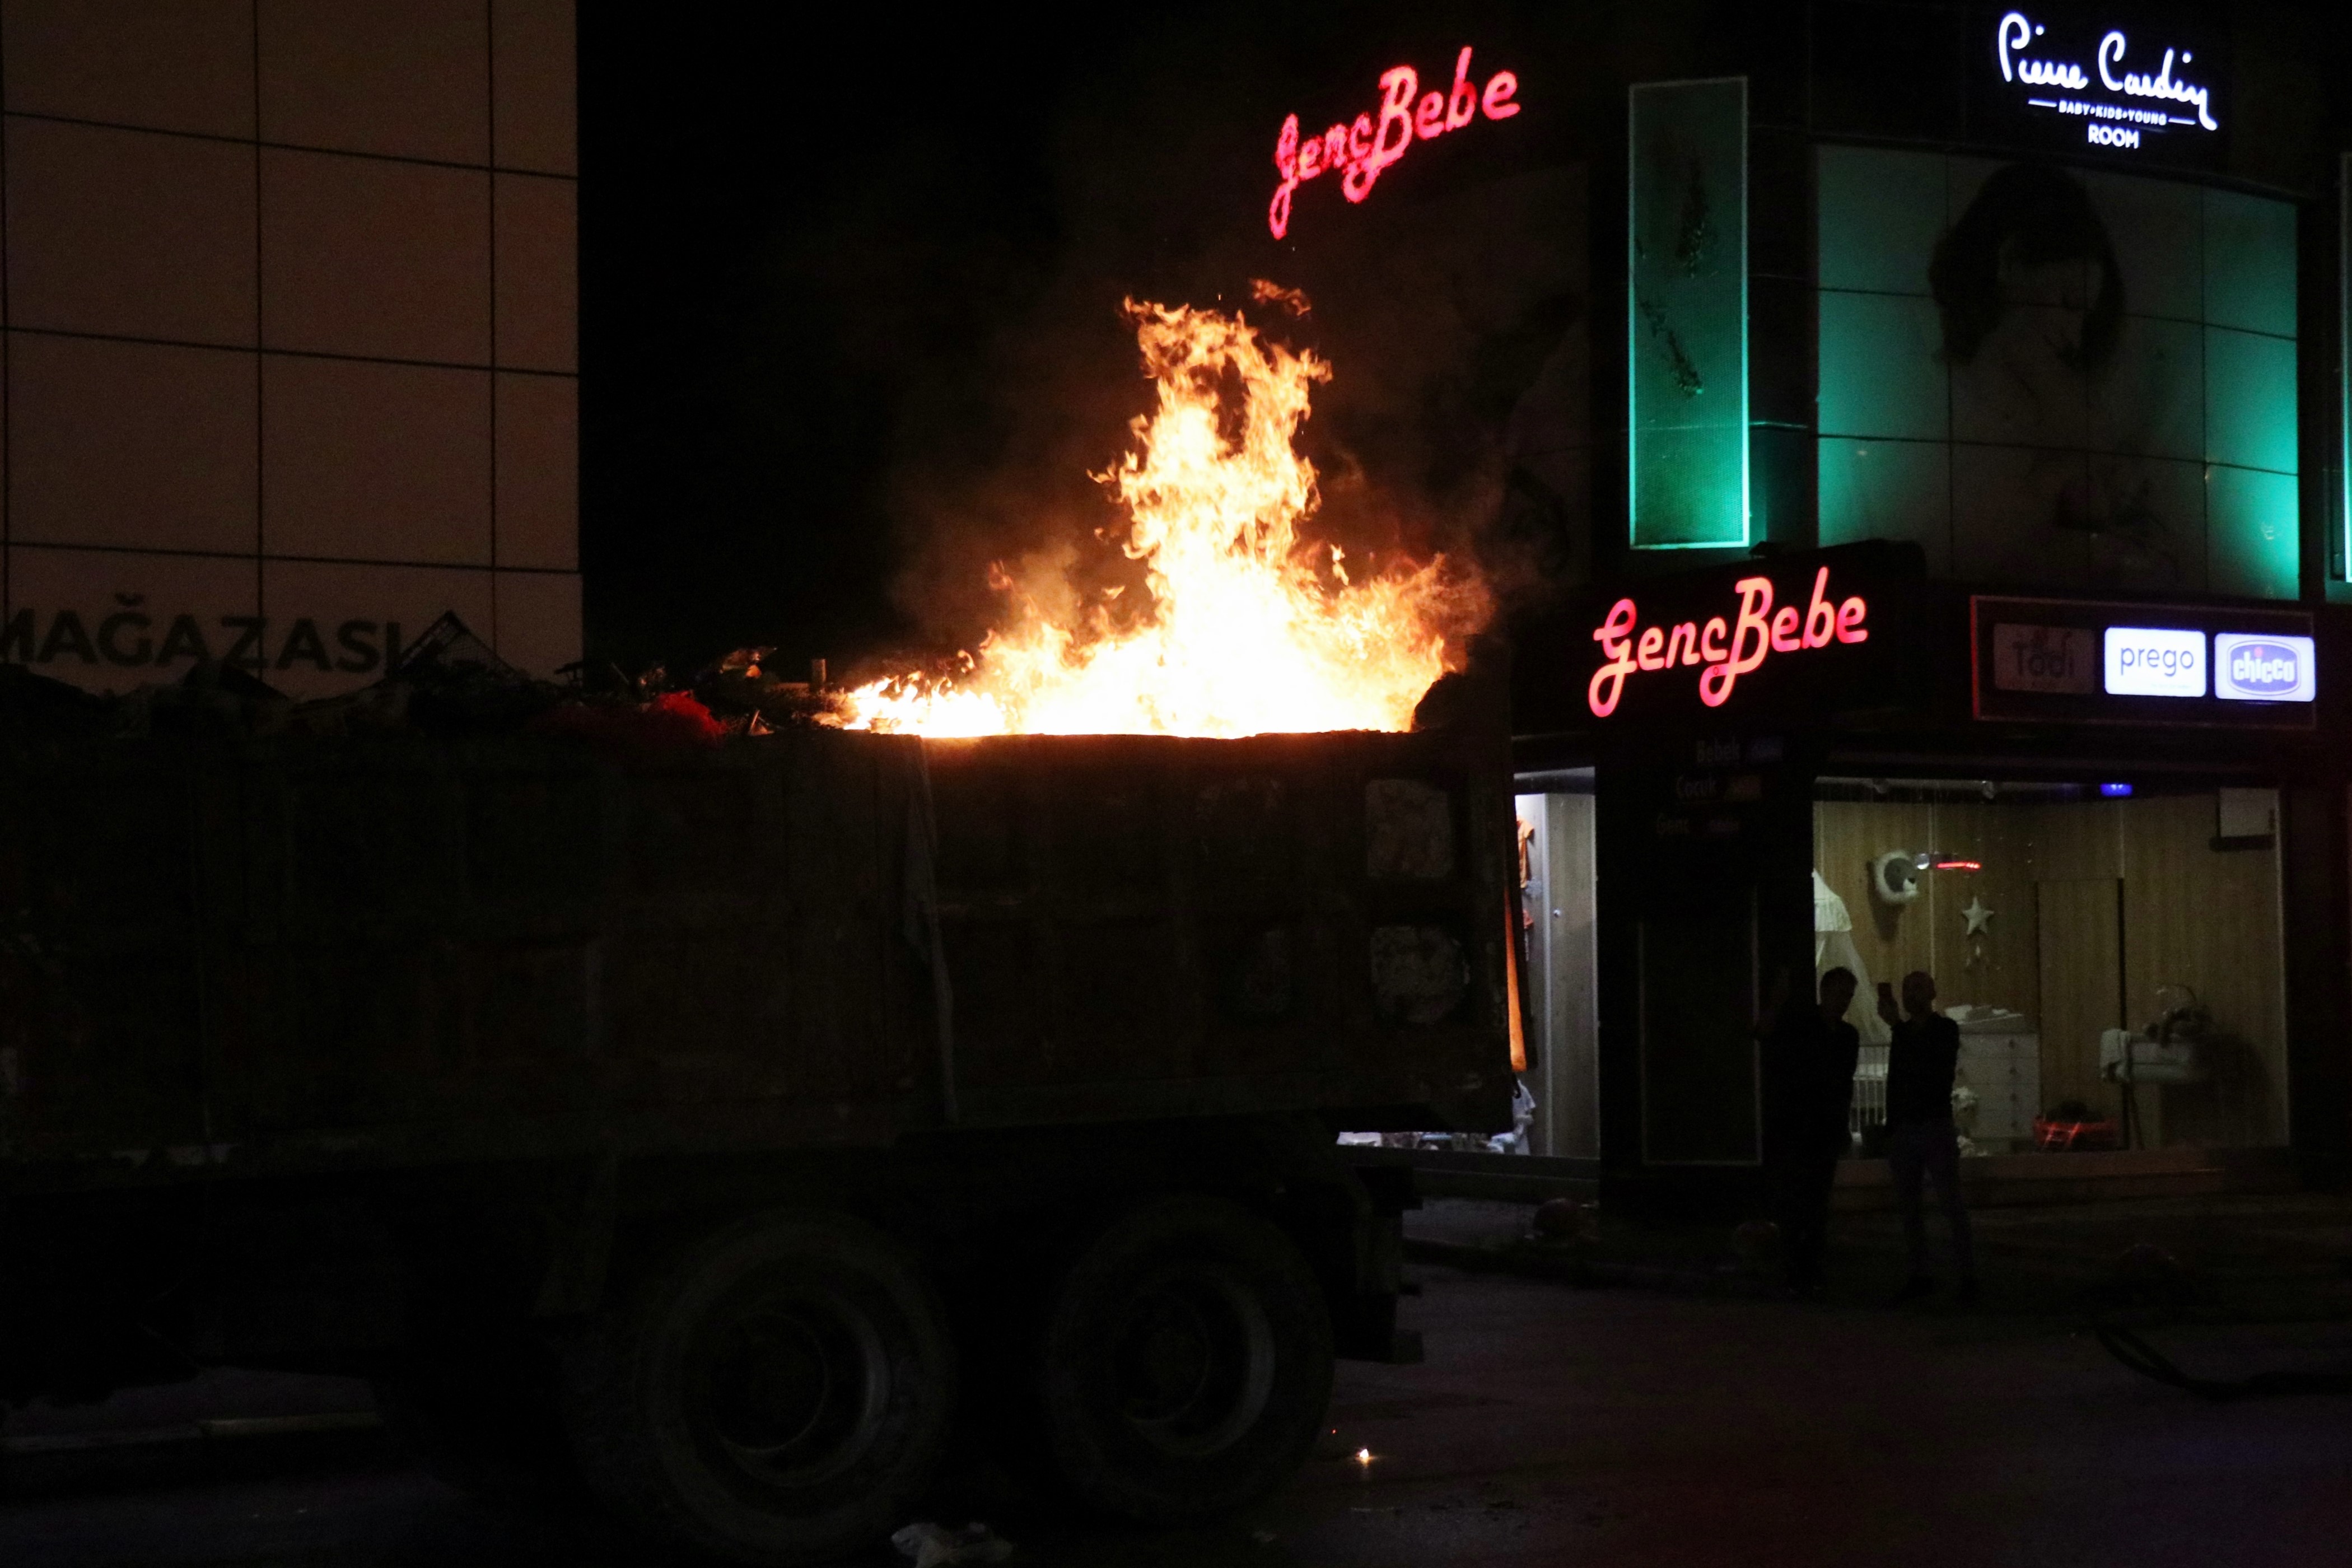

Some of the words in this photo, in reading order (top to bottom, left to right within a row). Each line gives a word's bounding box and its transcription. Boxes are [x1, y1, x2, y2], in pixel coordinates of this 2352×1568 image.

[1998, 11, 2089, 90] Pierre
[2098, 31, 2218, 131] Cardin
[2088, 123, 2140, 149] ROOM
[2120, 647, 2195, 677] prego
[2233, 646, 2295, 683] chicco
